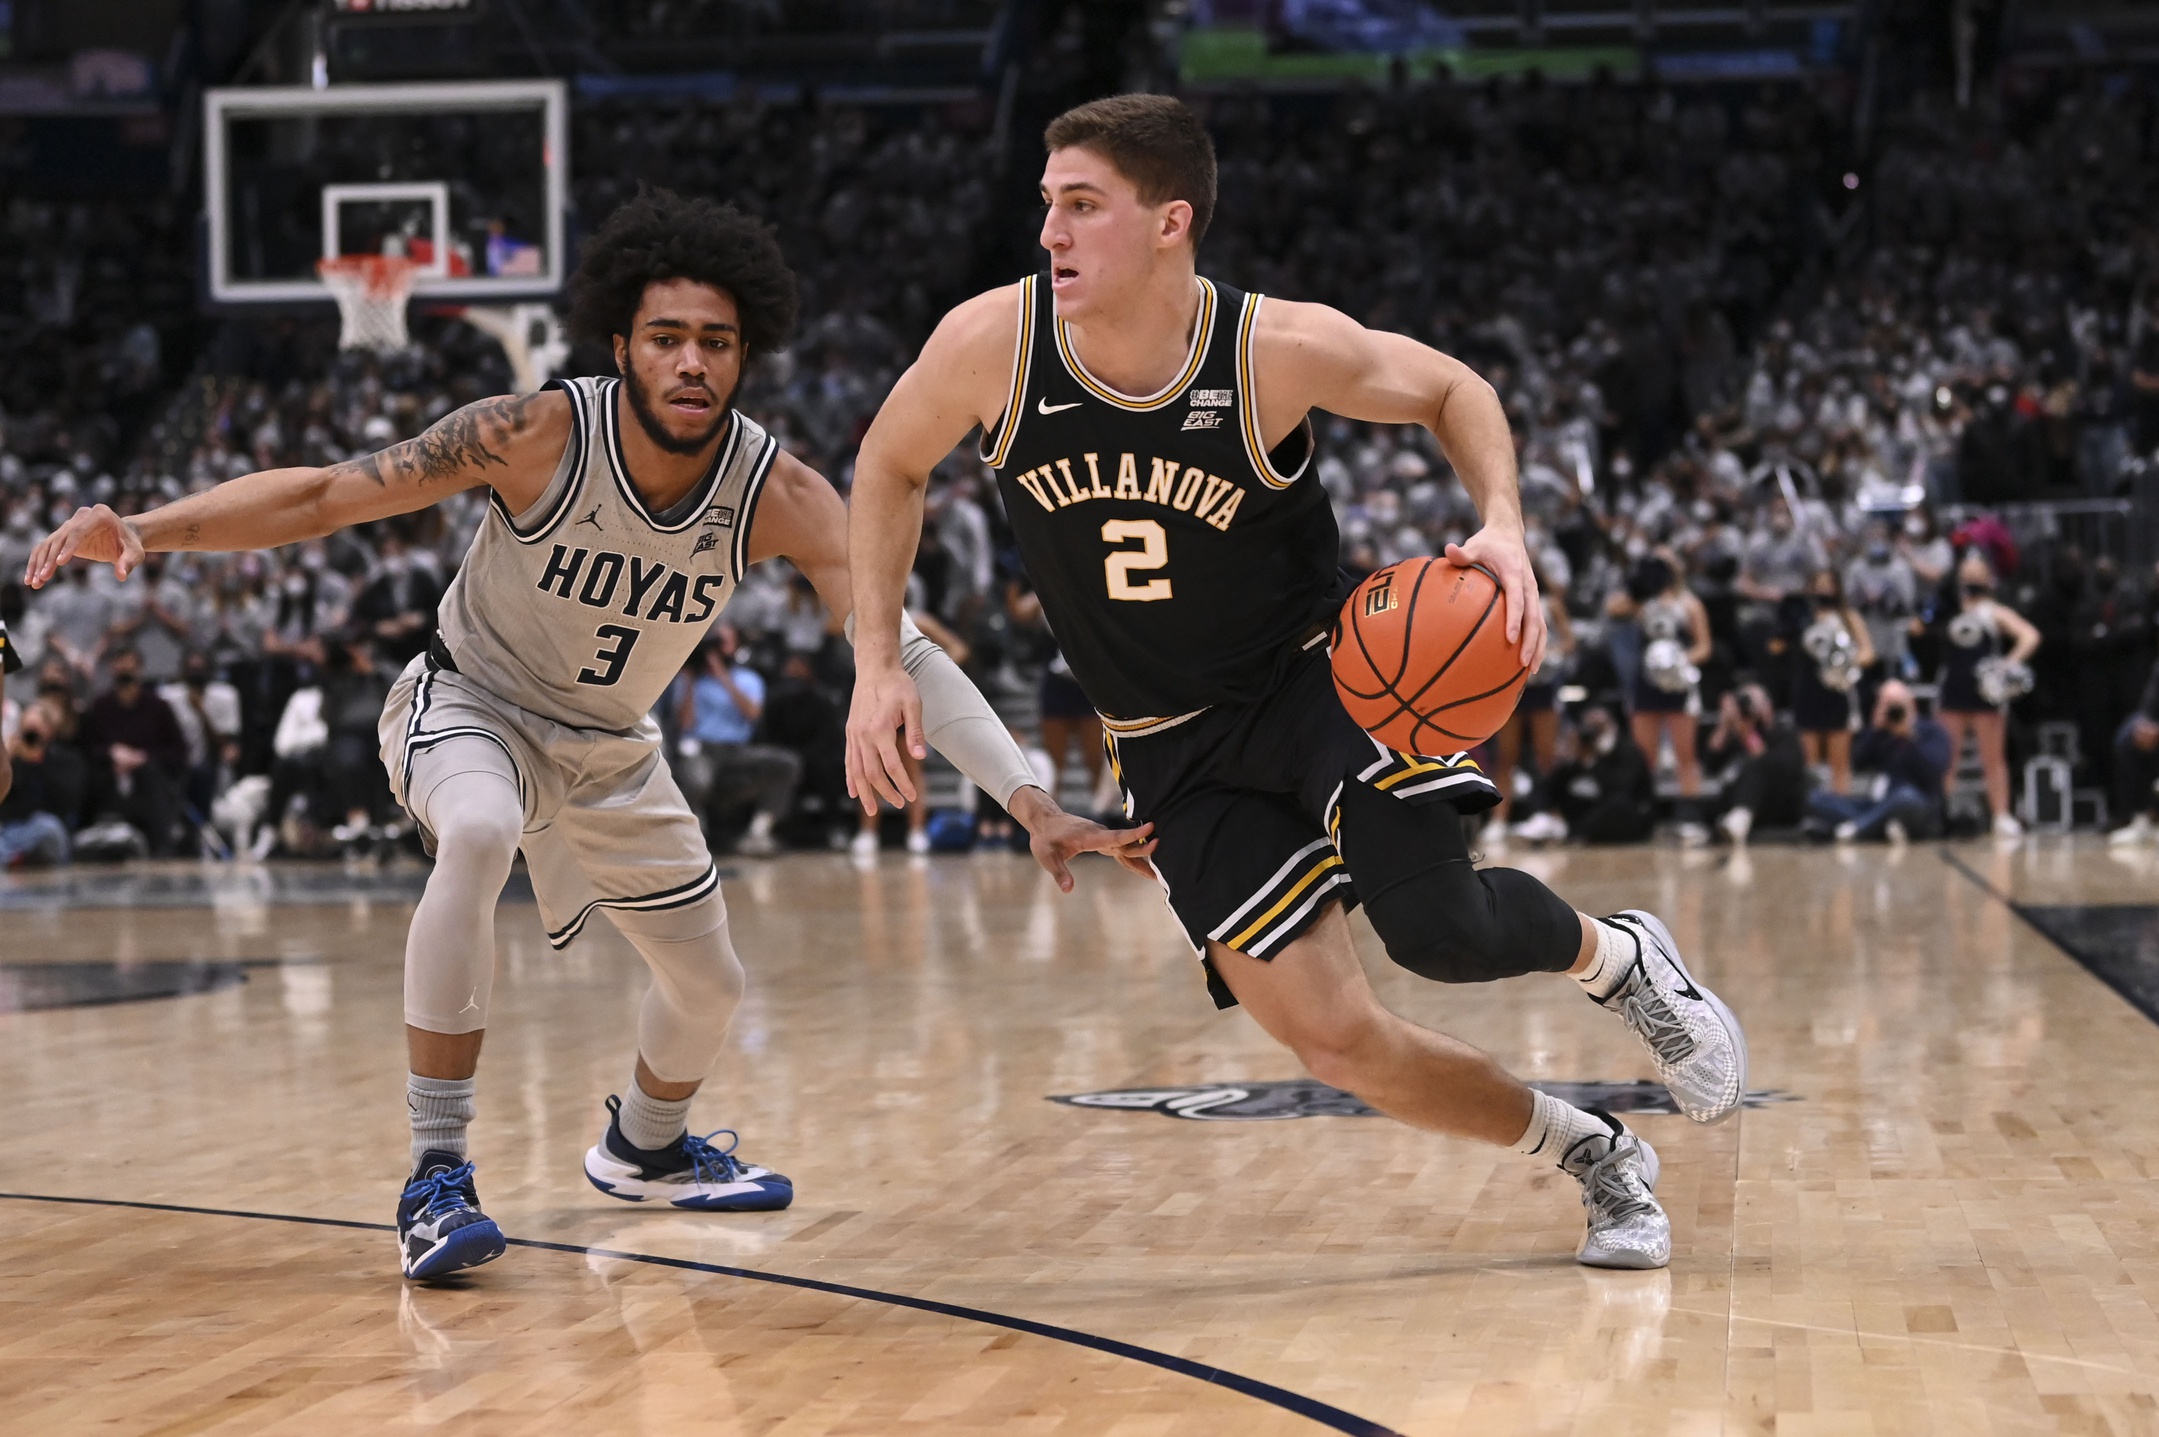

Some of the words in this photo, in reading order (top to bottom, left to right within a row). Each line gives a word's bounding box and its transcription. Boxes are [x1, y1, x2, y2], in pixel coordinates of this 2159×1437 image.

[1183, 418, 1223, 427] EAST
[1187, 410, 1217, 419] BIG
[1189, 399, 1233, 407] CHANGE
[1016, 452, 1246, 532] VILLANOVA
[536, 543, 725, 624] HOYAS
[1101, 518, 1173, 602] 2
[574, 622, 642, 688] 3
